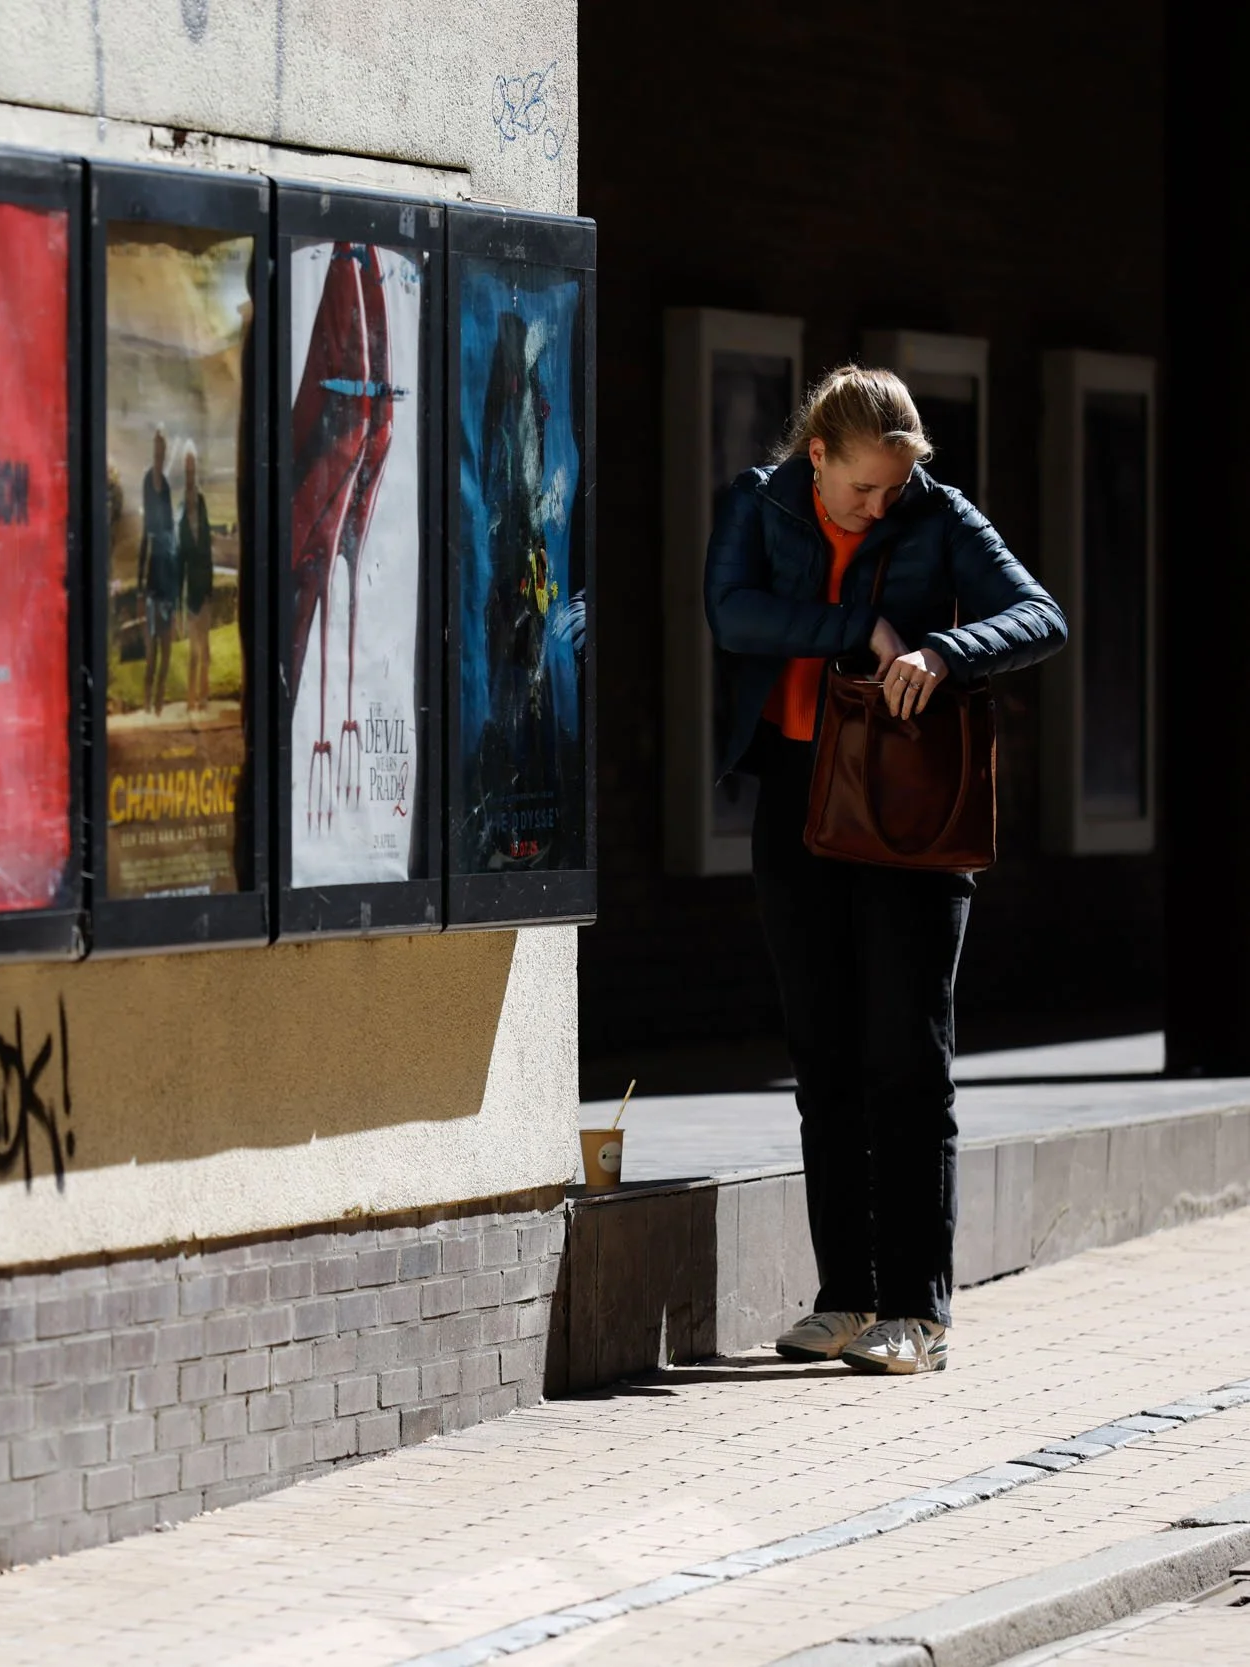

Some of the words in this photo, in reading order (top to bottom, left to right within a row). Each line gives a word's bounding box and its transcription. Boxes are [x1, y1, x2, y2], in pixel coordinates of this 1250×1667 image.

[365, 714, 408, 754] DEVIL
[109, 766, 241, 823] CHAMPAGNE
[369, 767, 406, 801] PRADA
